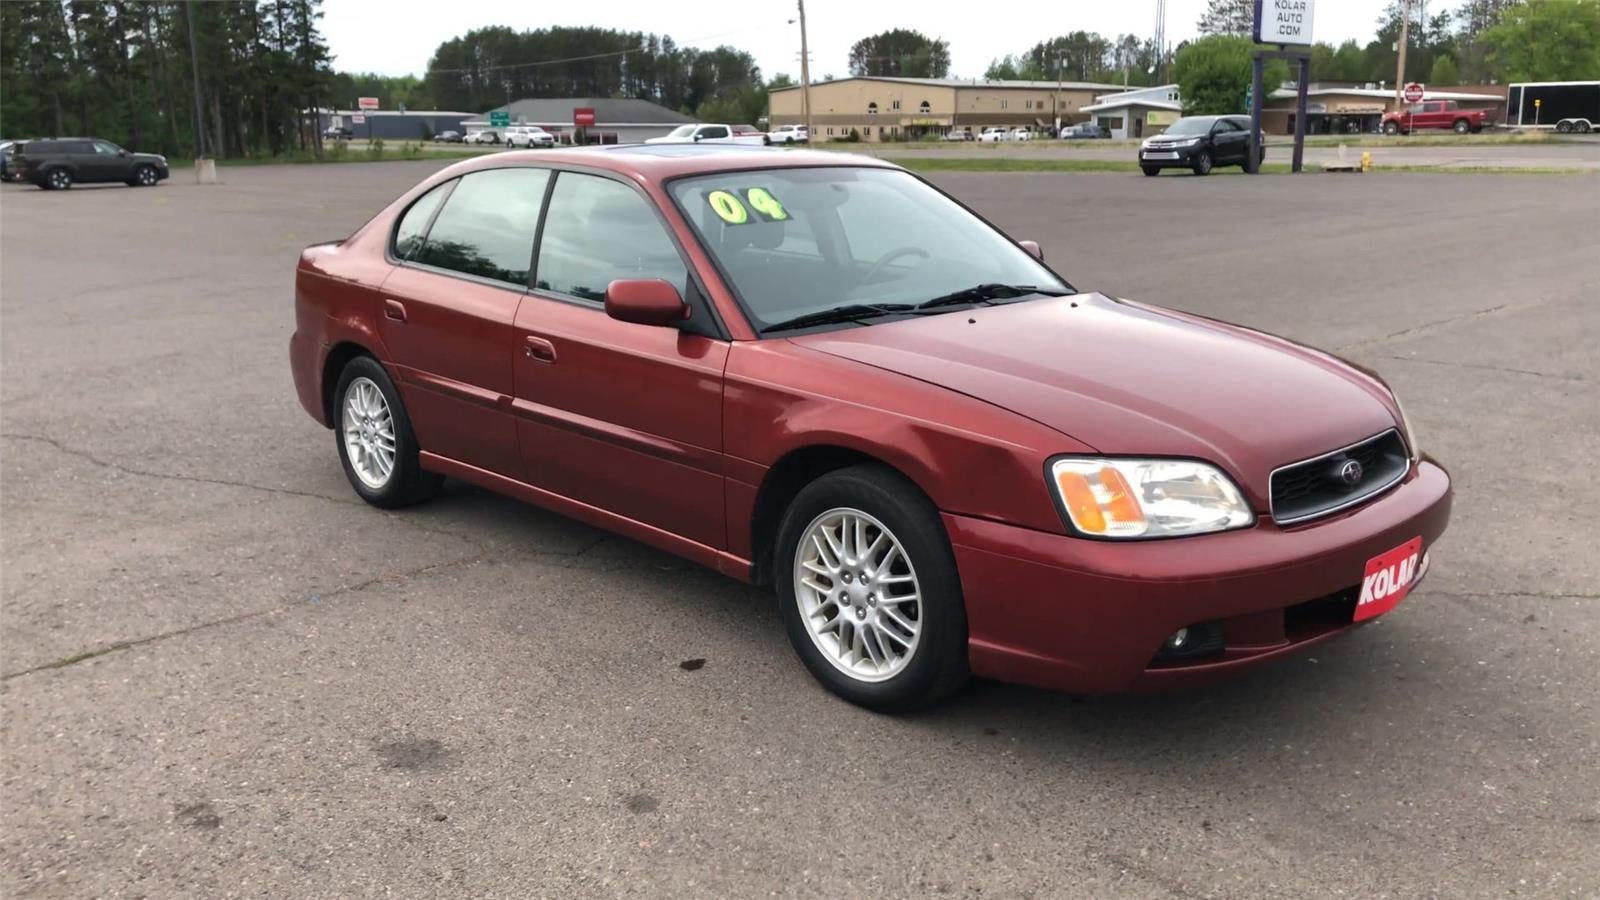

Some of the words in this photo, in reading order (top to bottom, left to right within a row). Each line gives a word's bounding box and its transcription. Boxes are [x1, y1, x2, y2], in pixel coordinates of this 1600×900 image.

[1274, 0, 1306, 10] KOLAR
[1277, 12, 1303, 23] AUTO
[1277, 25, 1301, 35] .COM
[708, 187, 787, 224] 04
